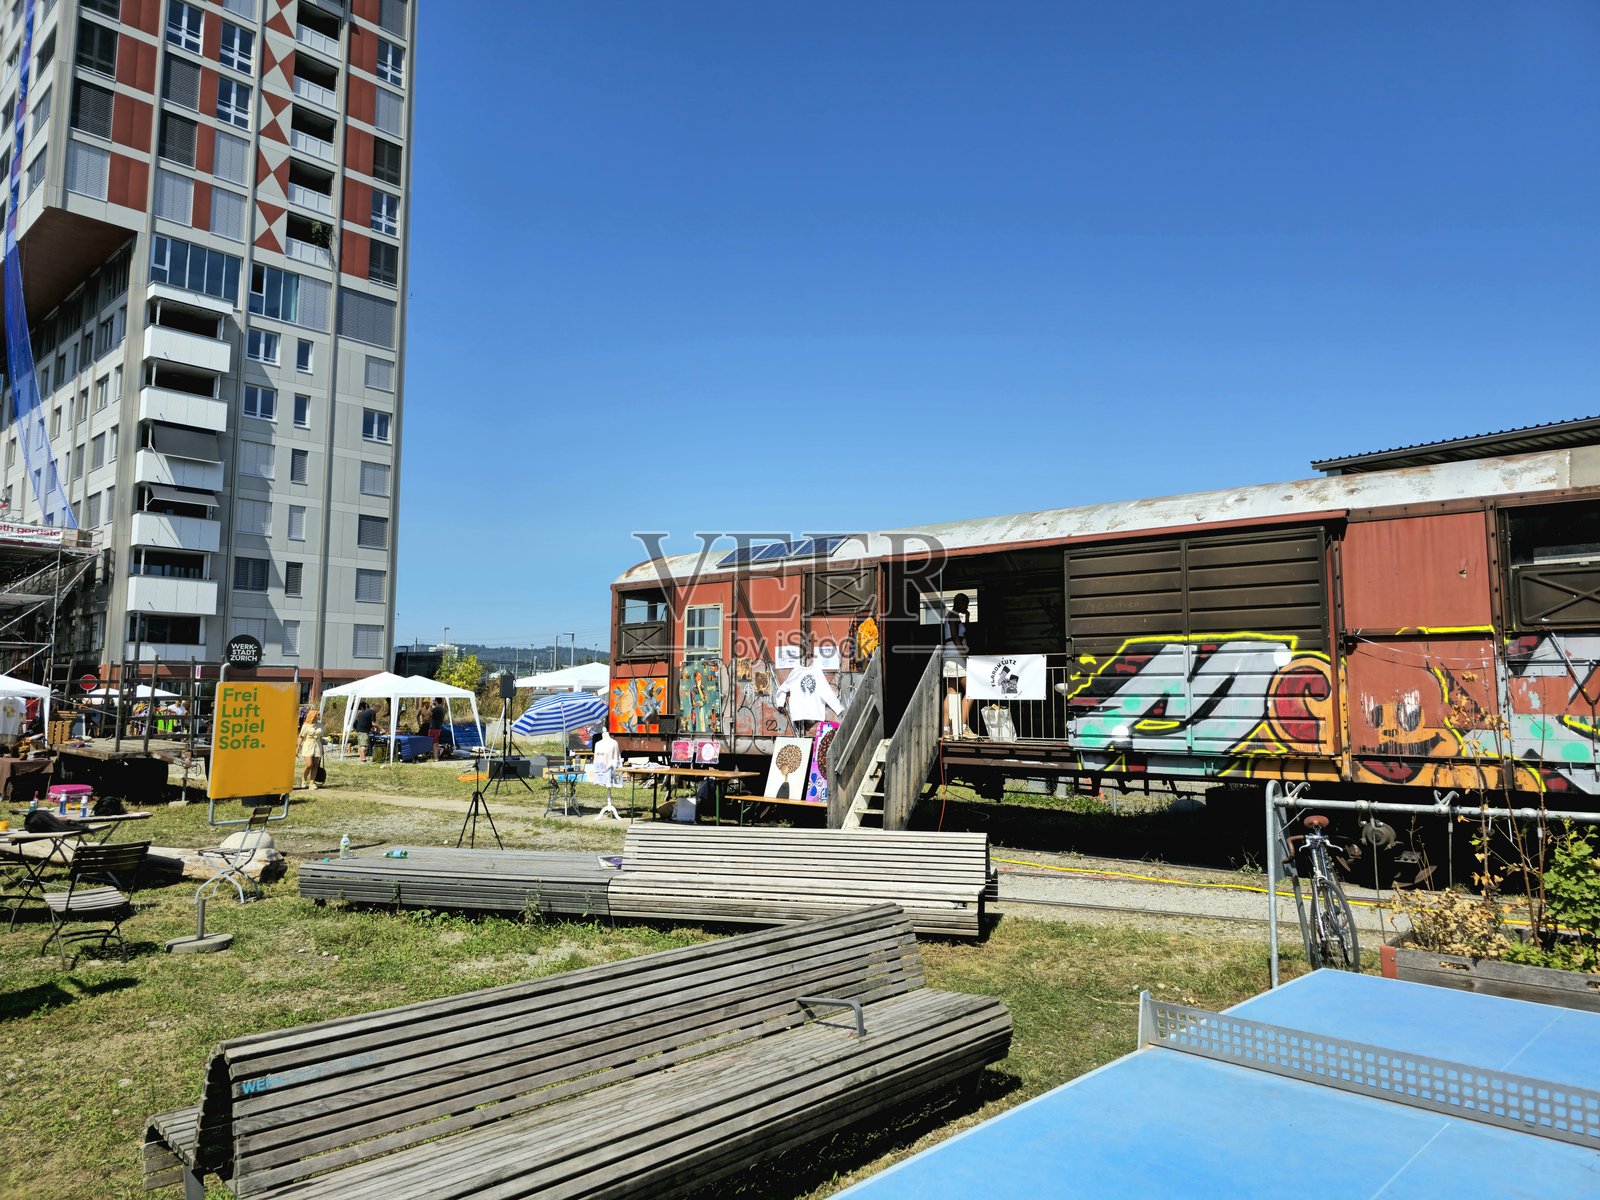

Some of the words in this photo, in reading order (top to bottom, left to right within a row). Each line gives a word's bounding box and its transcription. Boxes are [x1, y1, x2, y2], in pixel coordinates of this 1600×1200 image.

[223, 687, 258, 702] Frei
[221, 703, 260, 718] Luft
[220, 719, 265, 737] Spiel
[218, 735, 266, 750] Sofa.
